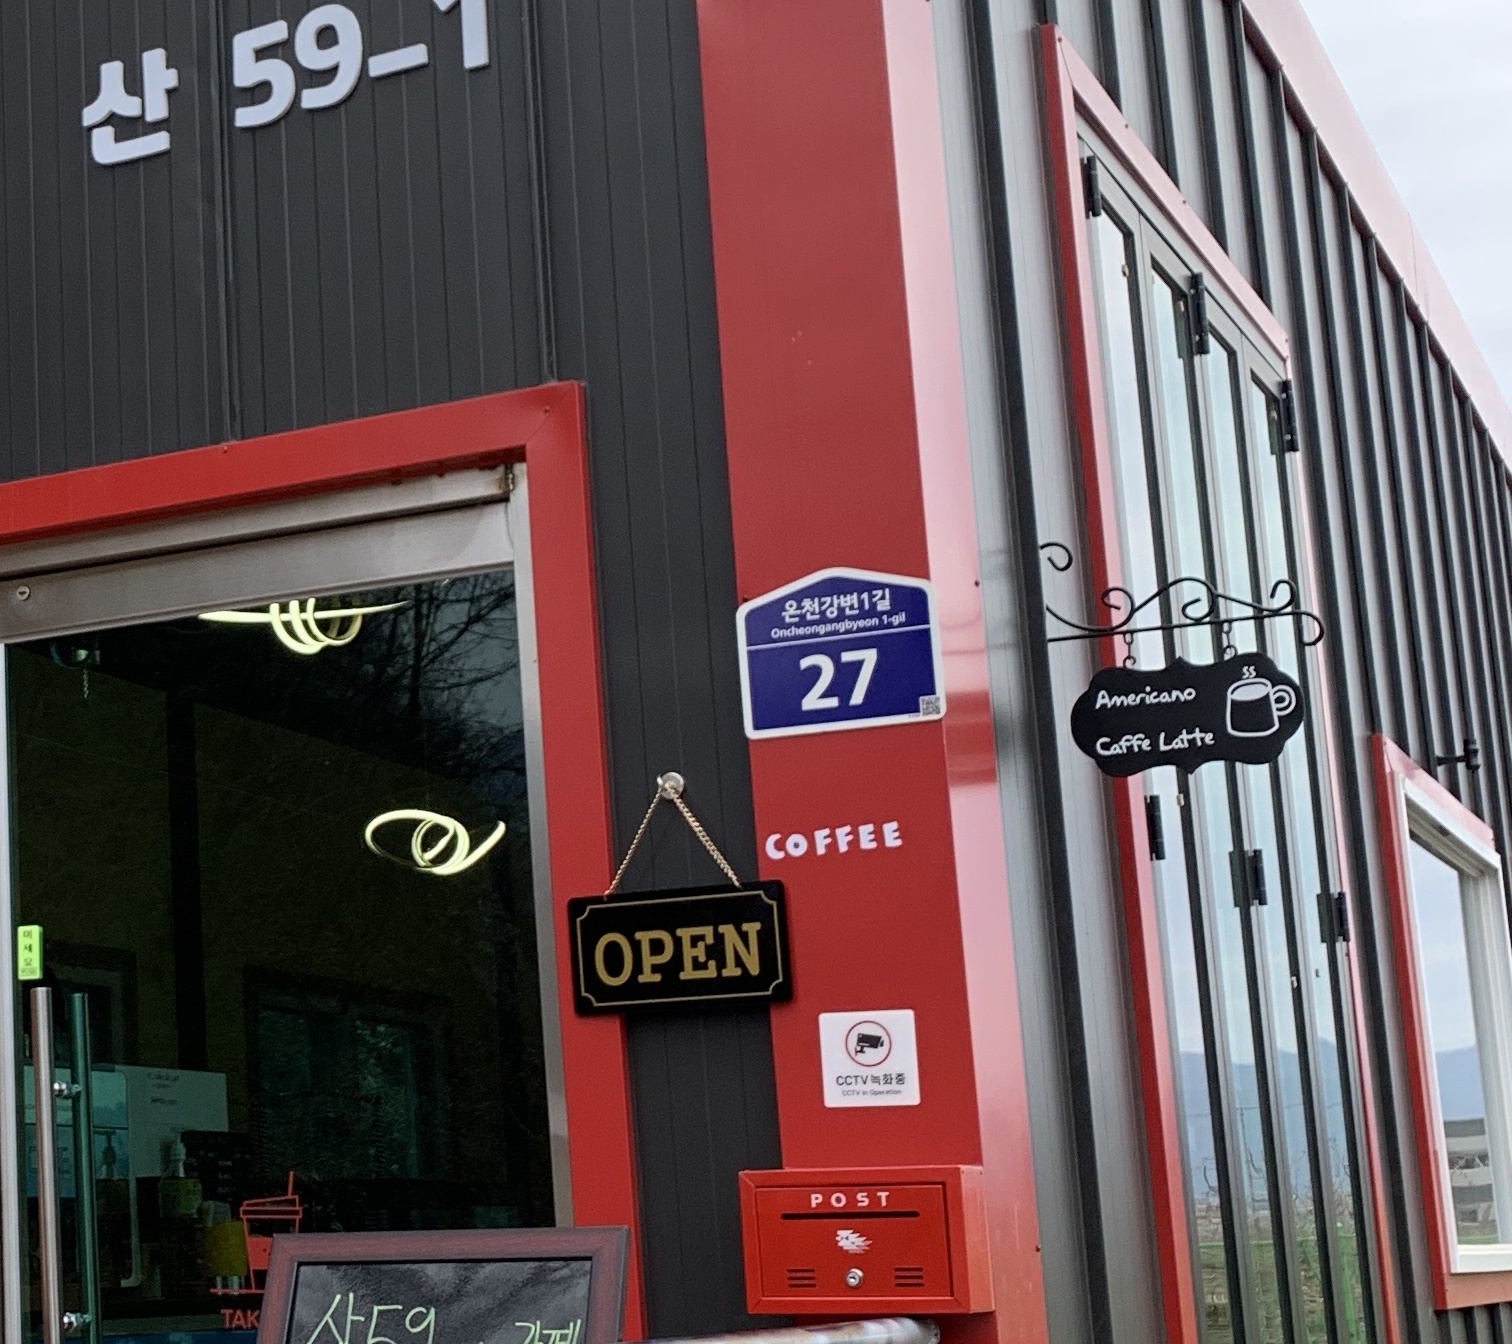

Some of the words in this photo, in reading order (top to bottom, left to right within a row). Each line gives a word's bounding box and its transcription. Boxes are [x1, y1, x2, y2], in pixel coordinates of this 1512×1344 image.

[82, 47, 179, 165] 산
[781, 588, 891, 623] 온천강변1길
[771, 615, 879, 639] Oncheongangbyeon
[882, 612, 906, 628] 1-gil
[799, 648, 878, 711] 27
[1095, 685, 1196, 709] Americano
[1096, 734, 1151, 756] Caffe
[1159, 727, 1215, 752] Latte
[765, 821, 903, 860] COFFEE
[594, 921, 762, 987] OPEN
[836, 1075, 869, 1086] CCTV
[871, 1072, 906, 1086] 녹화중
[810, 1191, 890, 1208] POST
[220, 1308, 260, 1329] TAK
